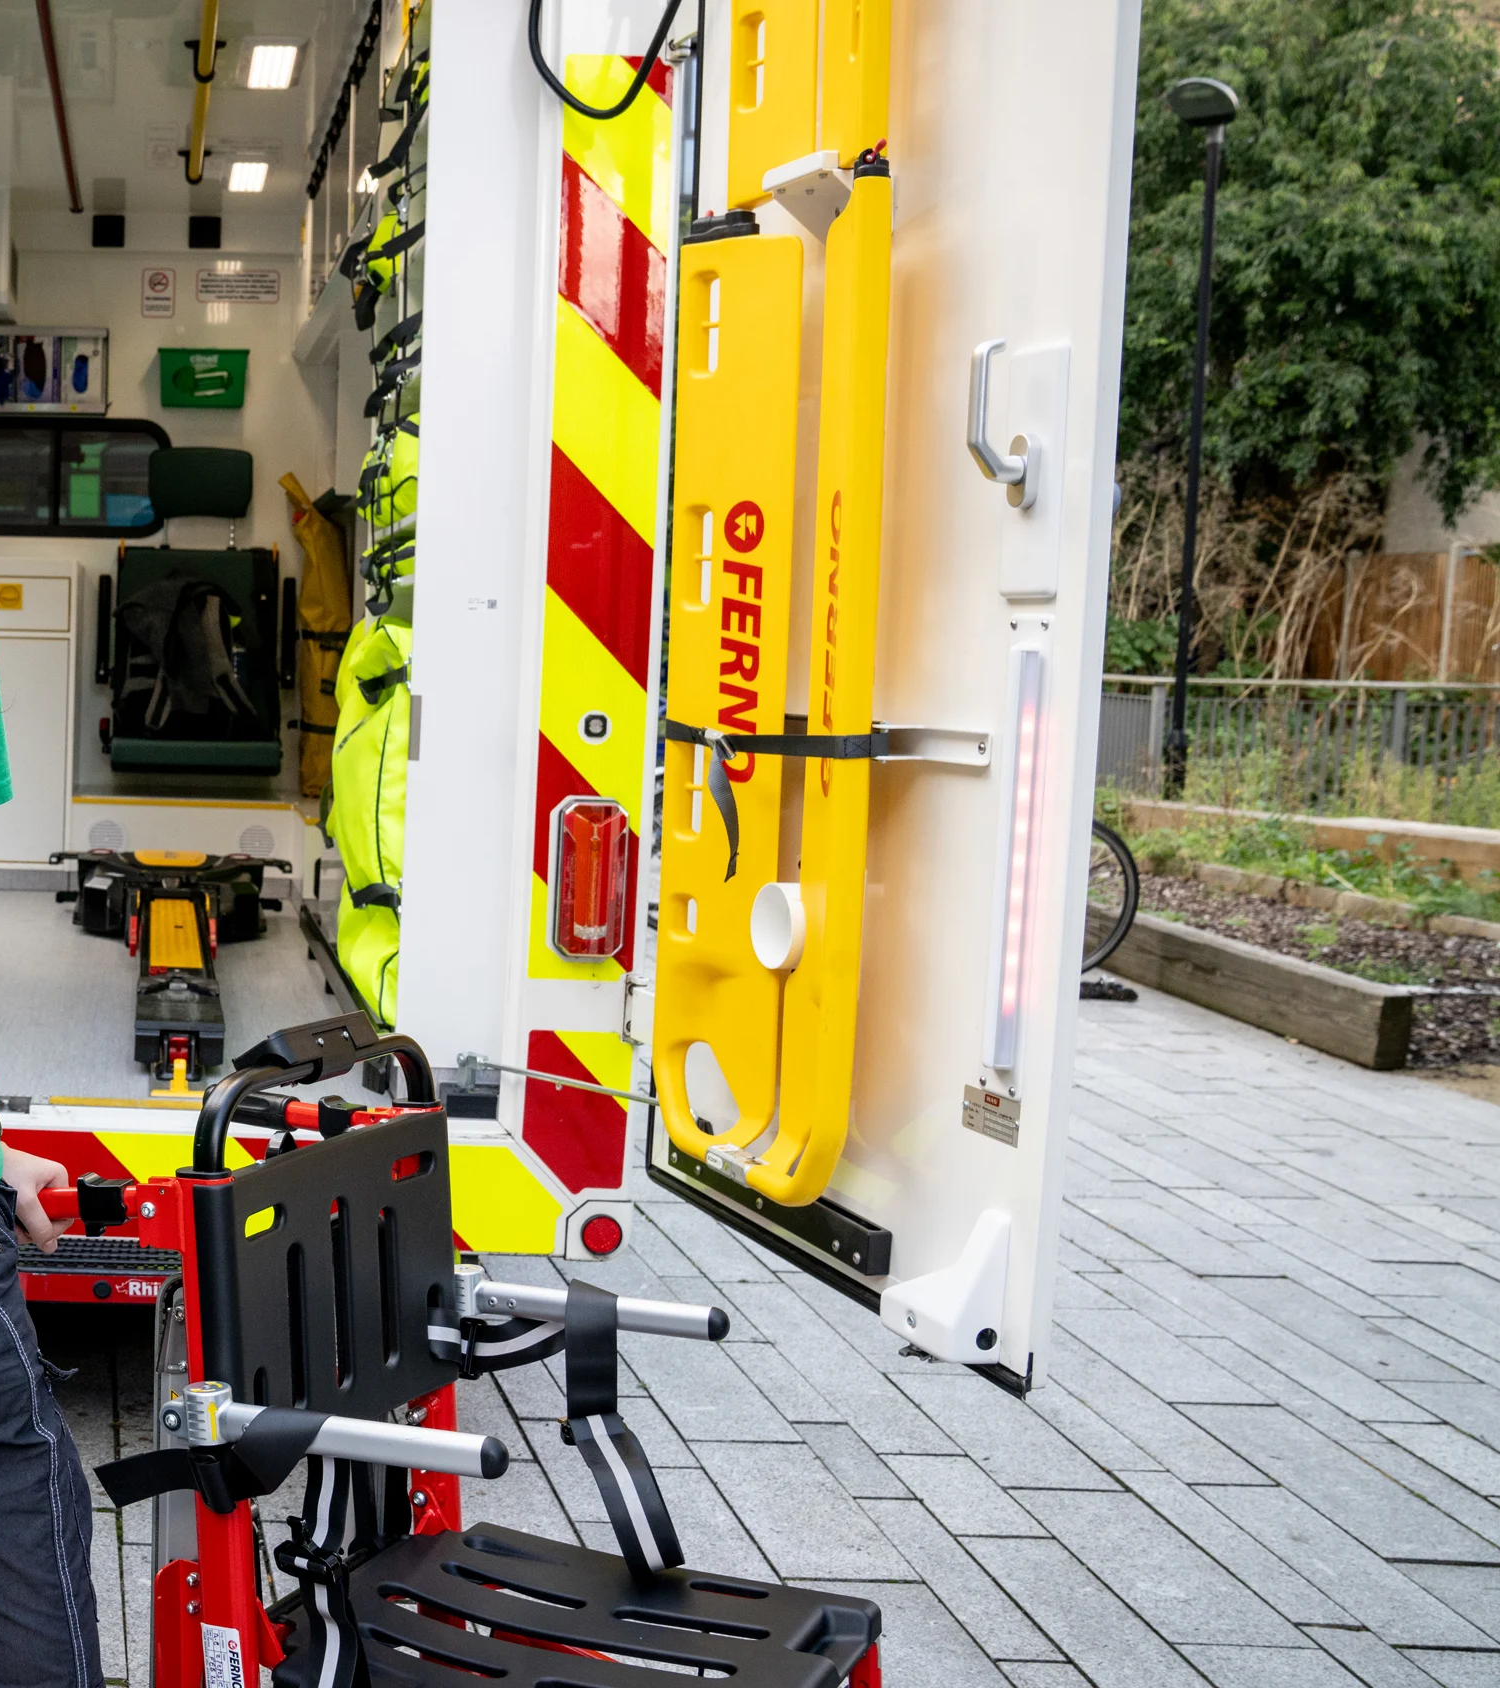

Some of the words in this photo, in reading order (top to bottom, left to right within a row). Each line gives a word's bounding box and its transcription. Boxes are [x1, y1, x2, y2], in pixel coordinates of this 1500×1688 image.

[717, 559, 763, 784] FERNO
[822, 490, 842, 735] FERNO
[129, 1282, 160, 1296] Rhi
